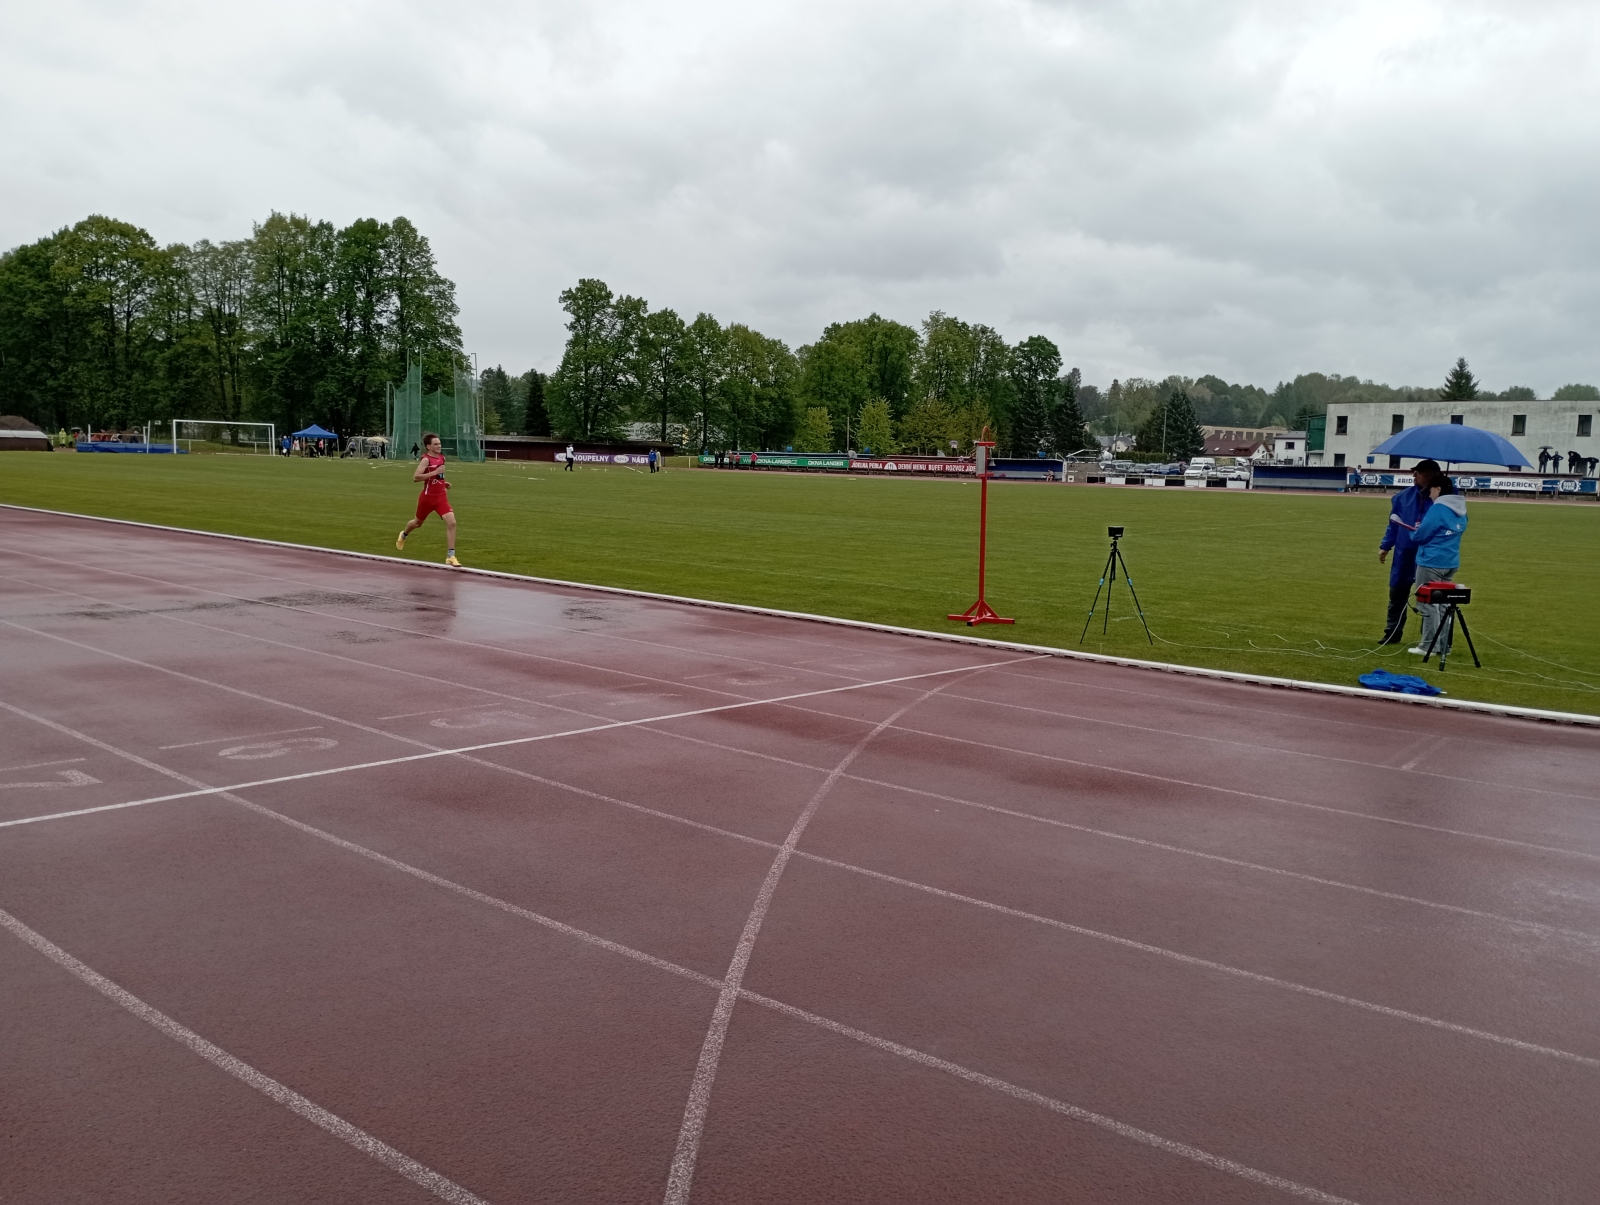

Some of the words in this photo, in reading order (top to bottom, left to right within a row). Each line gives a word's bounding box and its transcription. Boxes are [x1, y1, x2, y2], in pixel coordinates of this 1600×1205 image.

[573, 454, 609, 462] KOUPELNY
[632, 455, 649, 464] NÁBY
[945, 464, 964, 472] ROZVOZ
[965, 464, 977, 472] JÍDE
[218, 737, 339, 760] 6
[0, 769, 103, 790] 7
